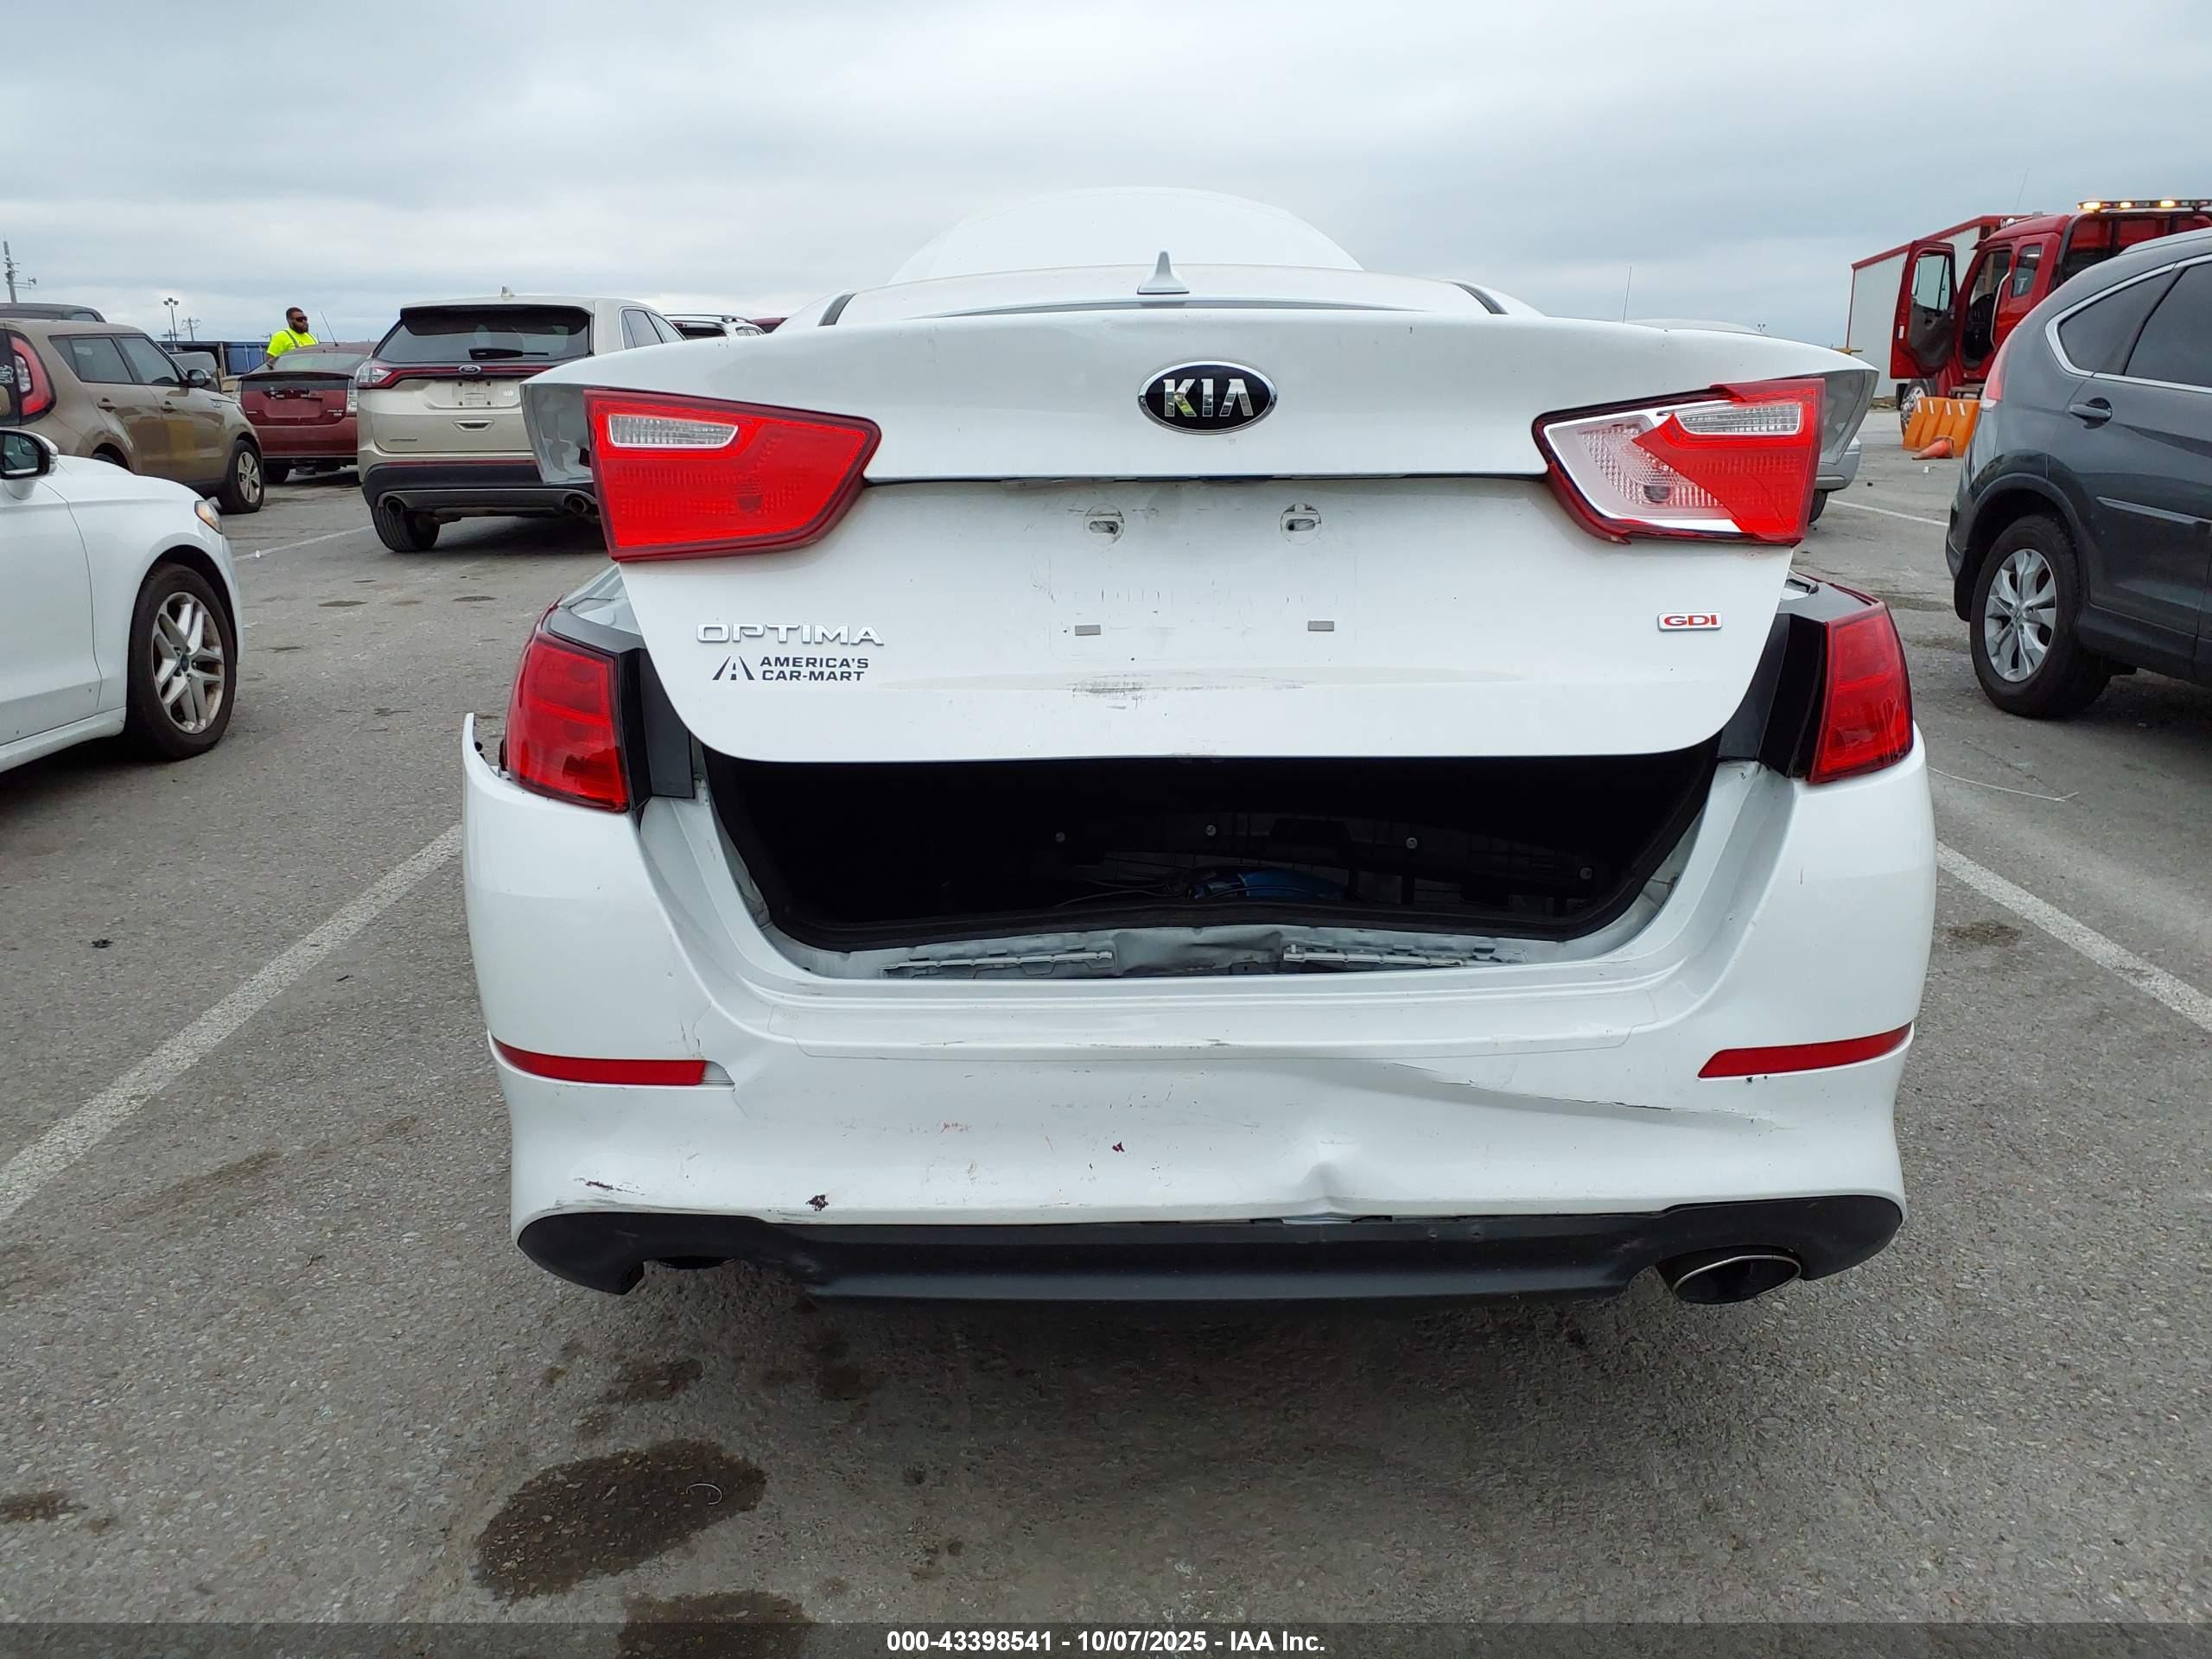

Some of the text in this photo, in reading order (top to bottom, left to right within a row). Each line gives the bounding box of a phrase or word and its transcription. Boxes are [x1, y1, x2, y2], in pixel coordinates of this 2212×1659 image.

[1163, 378, 1254, 416] KIA
[1664, 614, 1718, 626] GDI
[697, 623, 884, 646] OPTIMA
[760, 656, 869, 669] AMERICA'S
[762, 670, 865, 682] CAR-MART
